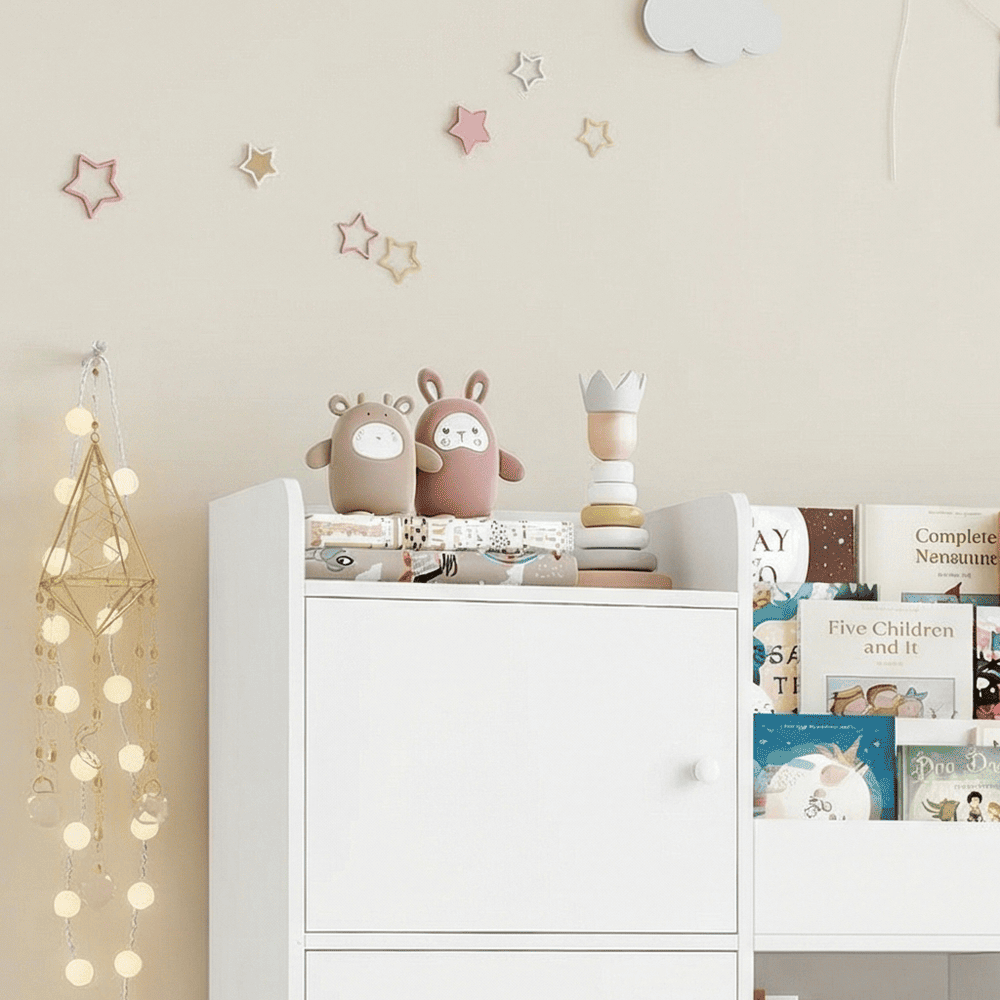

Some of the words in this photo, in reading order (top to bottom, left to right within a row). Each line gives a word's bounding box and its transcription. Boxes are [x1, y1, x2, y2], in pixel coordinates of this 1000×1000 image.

[916, 528, 997, 547] Complete
[829, 620, 867, 635] Five
[864, 640, 898, 655] and
[906, 641, 918, 655] It
